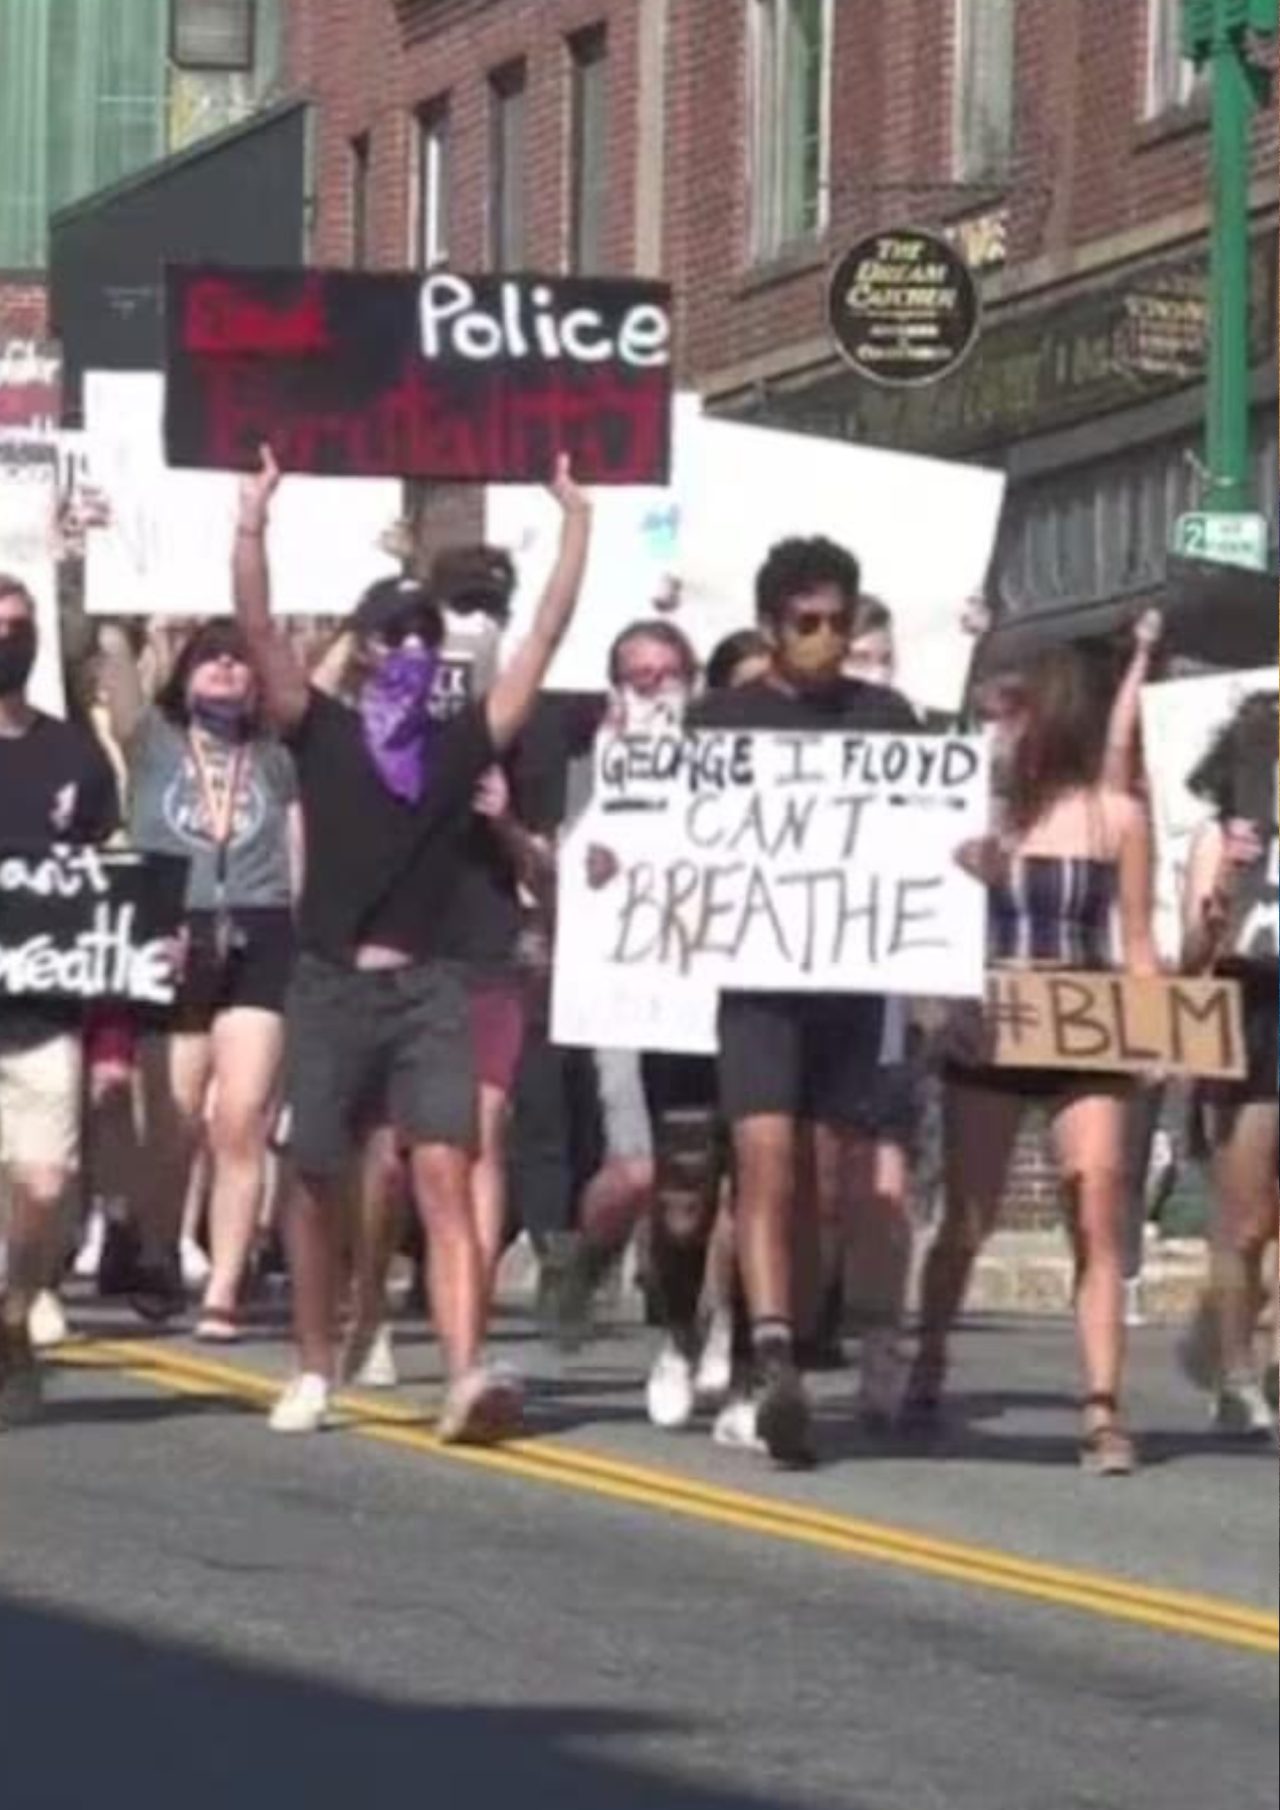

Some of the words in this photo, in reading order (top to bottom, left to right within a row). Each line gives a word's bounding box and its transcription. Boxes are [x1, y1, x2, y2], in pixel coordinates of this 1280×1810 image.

[419, 274, 669, 366] Police
[602, 733, 755, 793] GEORGE
[773, 735, 826, 786] I
[842, 738, 979, 787] FLOYD
[0, 844, 109, 896] an't
[0, 901, 176, 1004] reathe
[606, 860, 953, 975] BREATHE
[986, 977, 1233, 1069] #BLM
